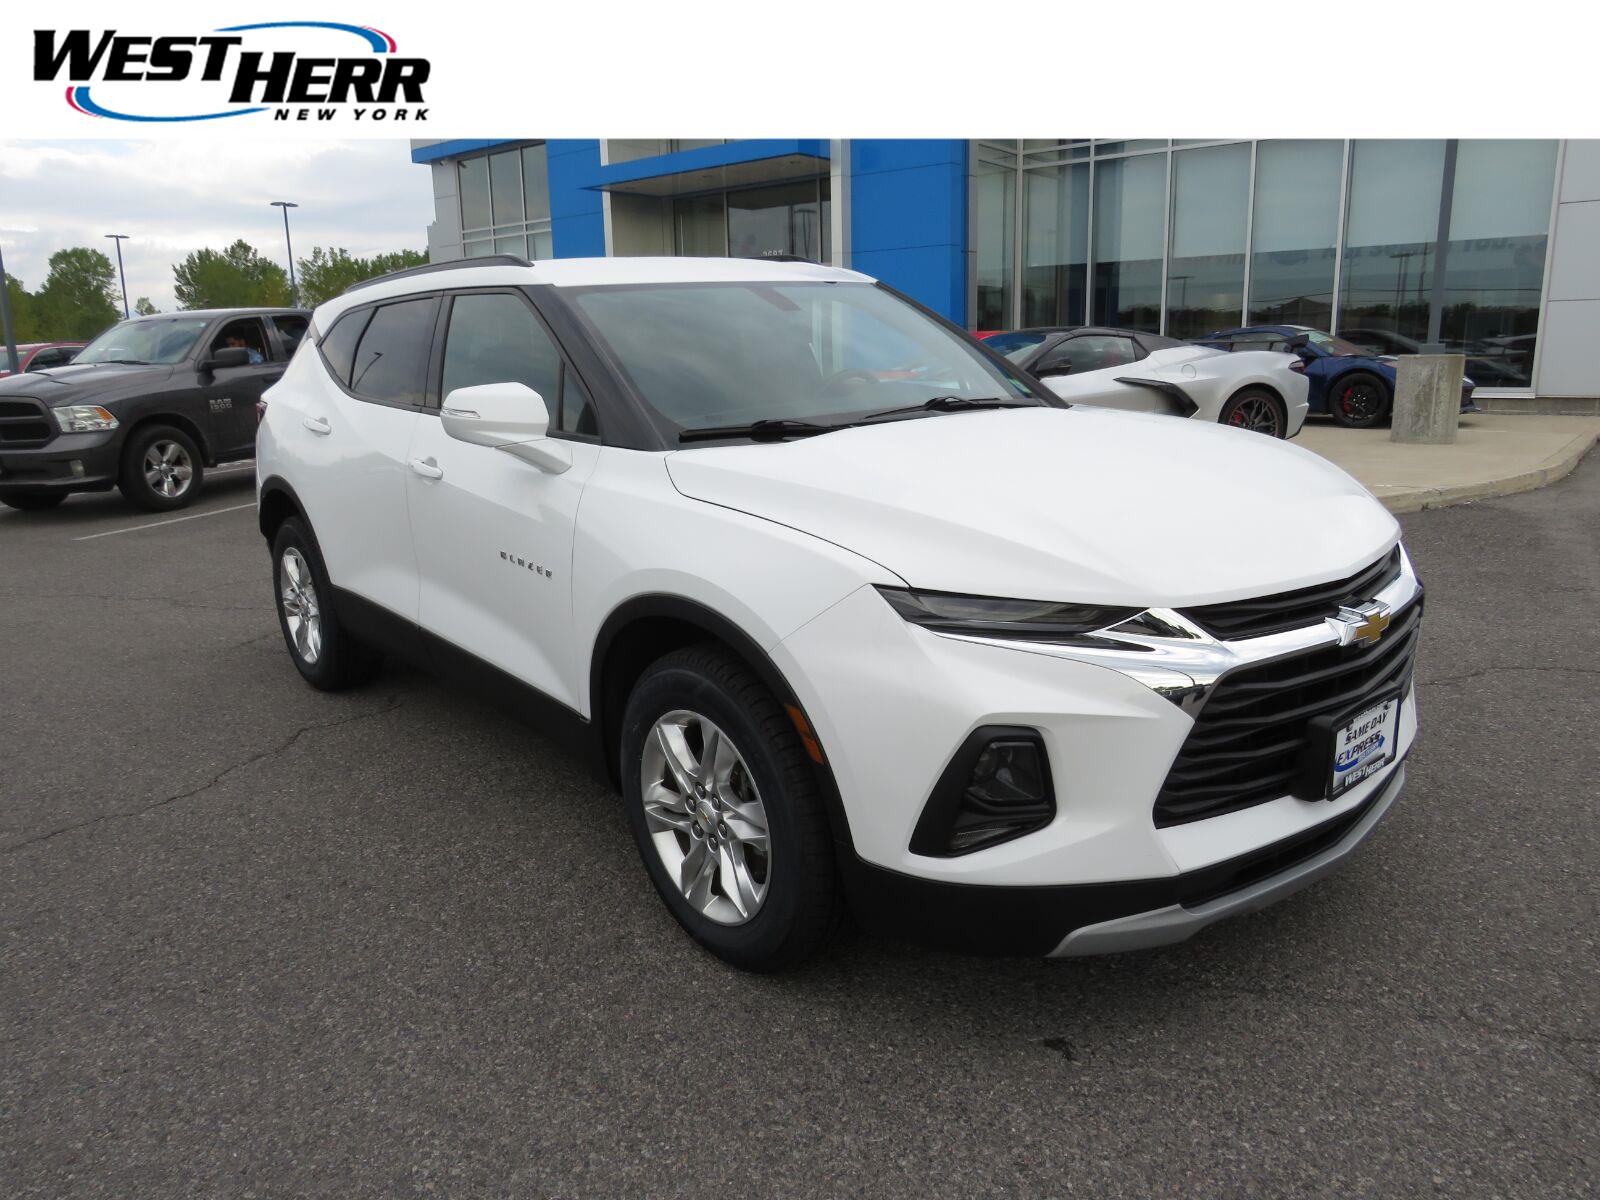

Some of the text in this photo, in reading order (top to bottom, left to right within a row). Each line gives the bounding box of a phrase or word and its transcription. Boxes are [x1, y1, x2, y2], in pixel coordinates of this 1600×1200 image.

[500, 551, 552, 579] BLAZER
[1345, 710, 1388, 745] SAME DAY
[1337, 730, 1382, 763] EXPRESS
